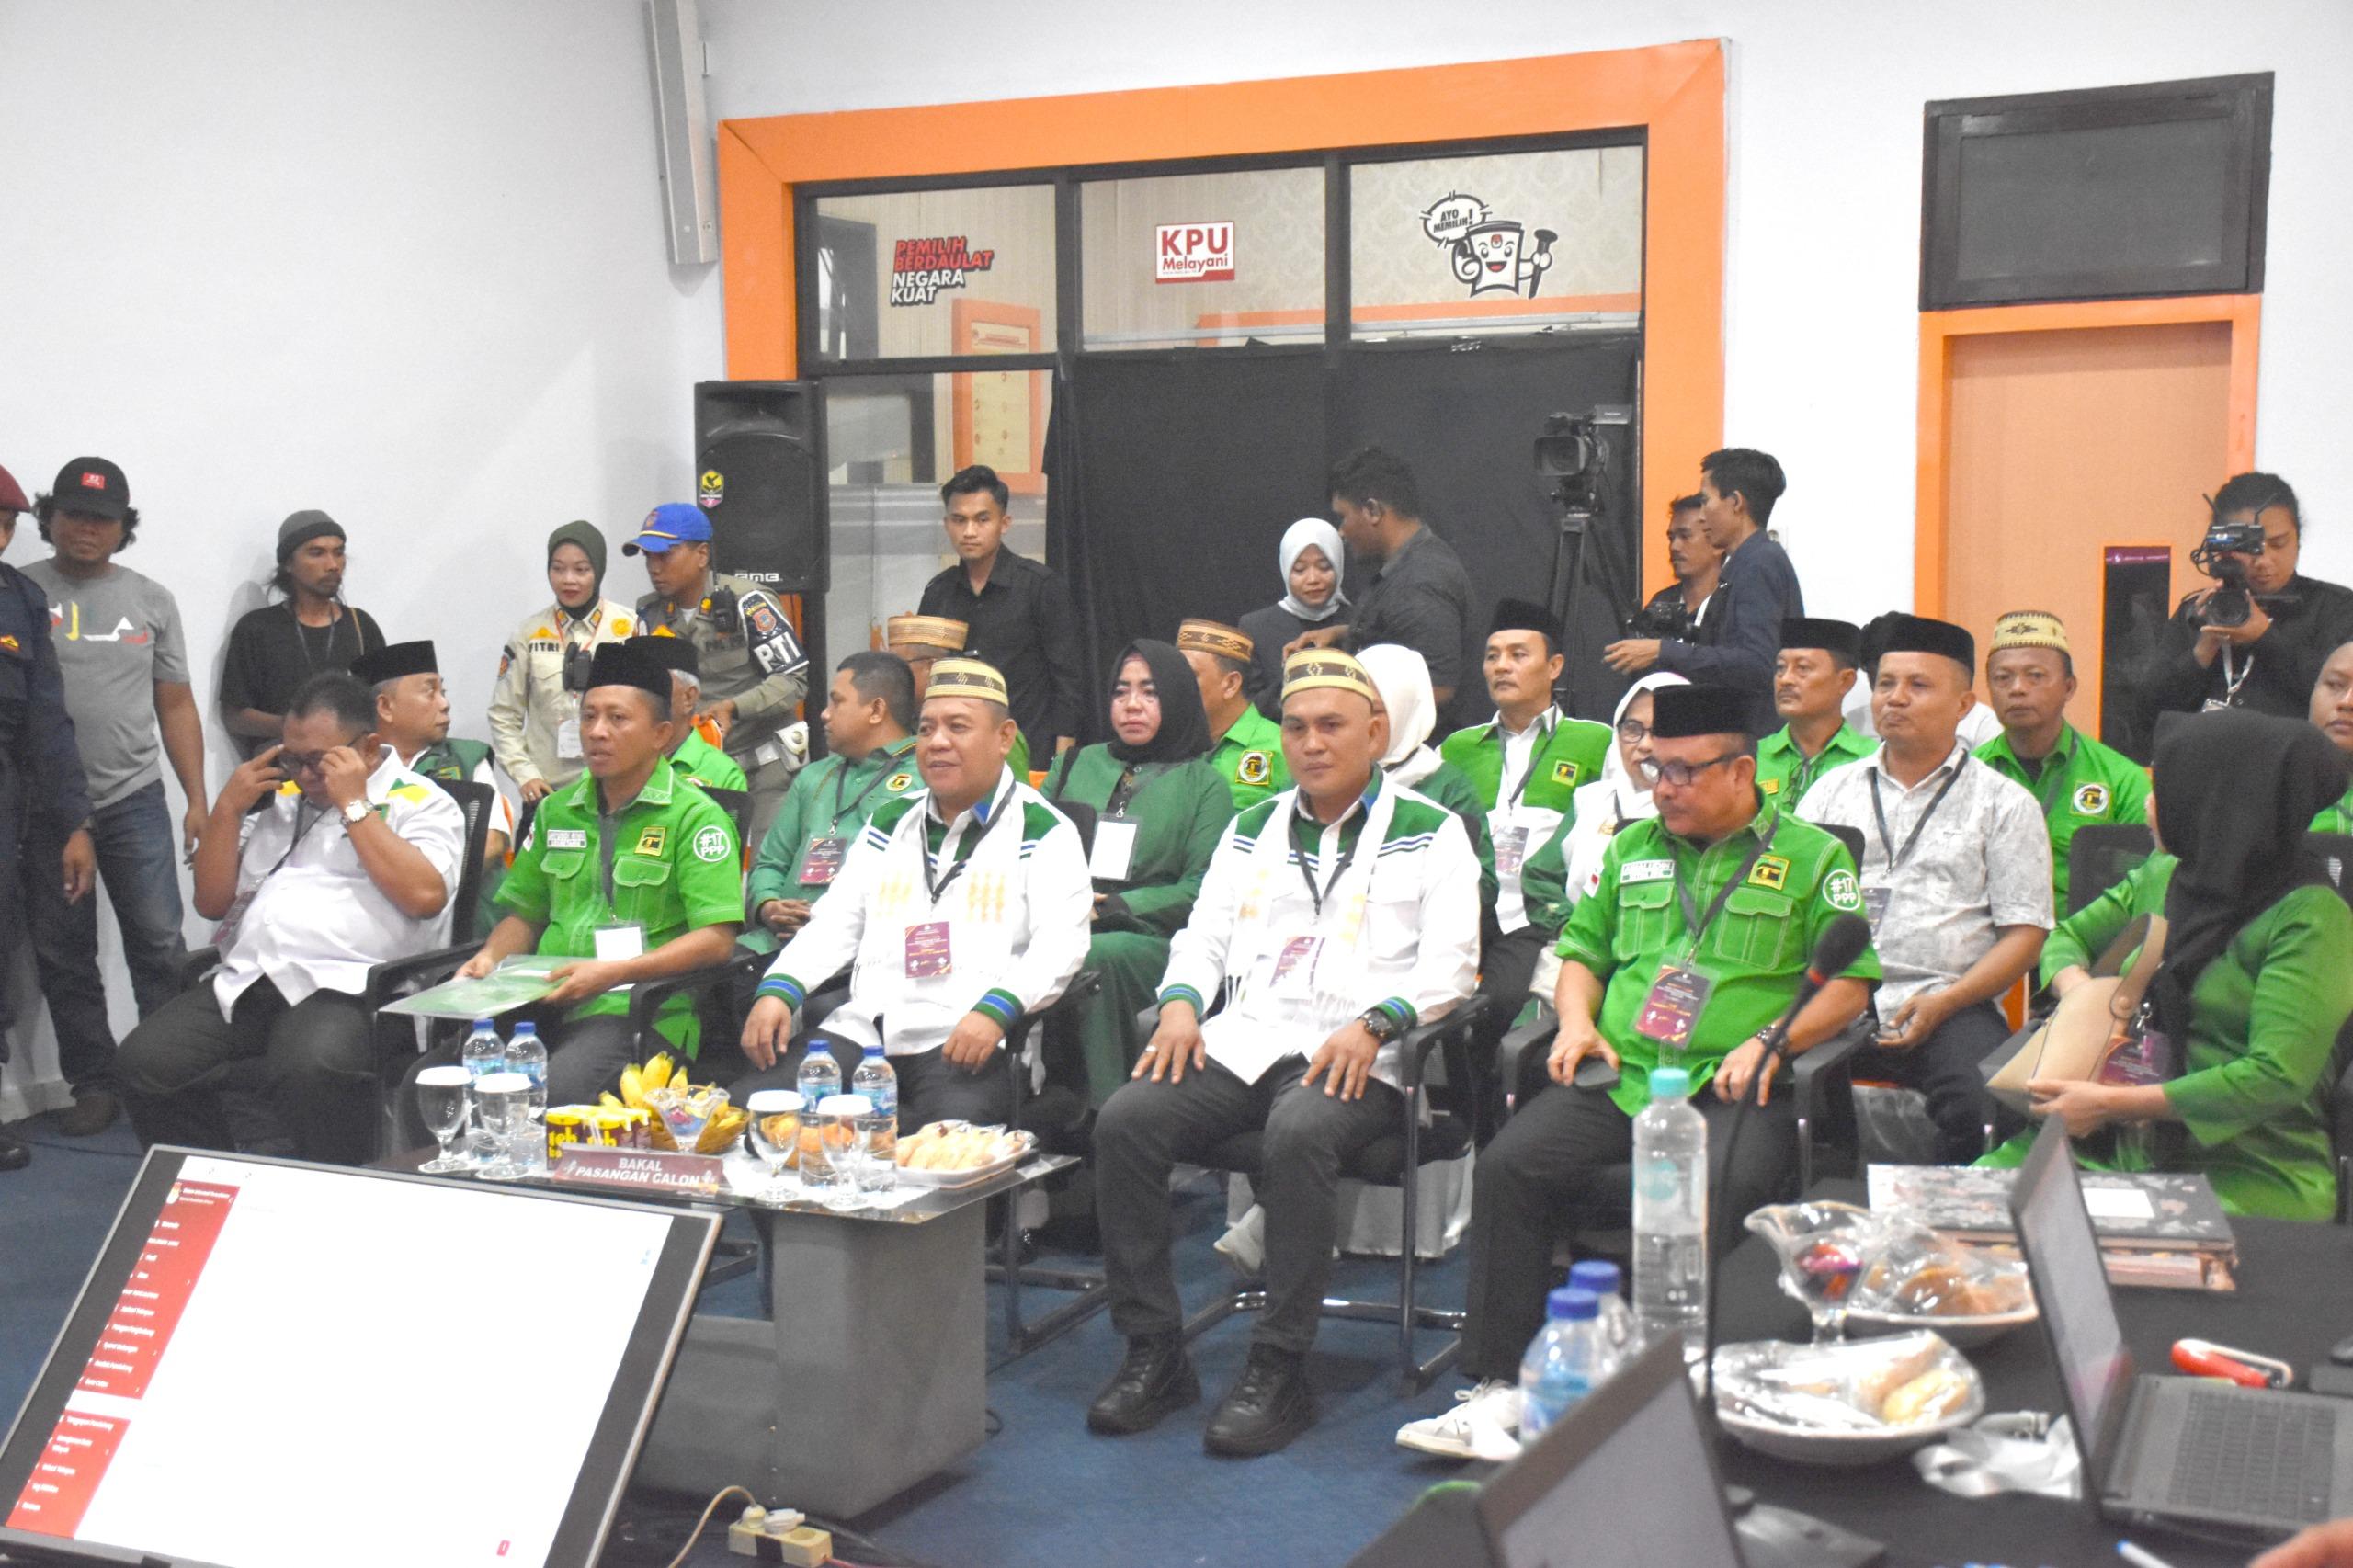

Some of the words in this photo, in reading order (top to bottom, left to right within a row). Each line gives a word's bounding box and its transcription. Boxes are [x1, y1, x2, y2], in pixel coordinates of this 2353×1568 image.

[1440, 209, 1459, 222] AYO
[895, 236, 967, 257] PEMILIH
[1161, 227, 1228, 256] KPU
[893, 249, 995, 272] BERDAULAT
[1162, 252, 1228, 273] Melayani
[892, 268, 965, 288] NEGARA
[890, 286, 937, 304] KUAT
[754, 631, 801, 674] PTI
[700, 845, 725, 858] PPP
[1833, 892, 1857, 905] PPP
[618, 1157, 663, 1173] BAKAL
[574, 1166, 651, 1184] PASANGAN
[652, 1173, 700, 1187] CALON
